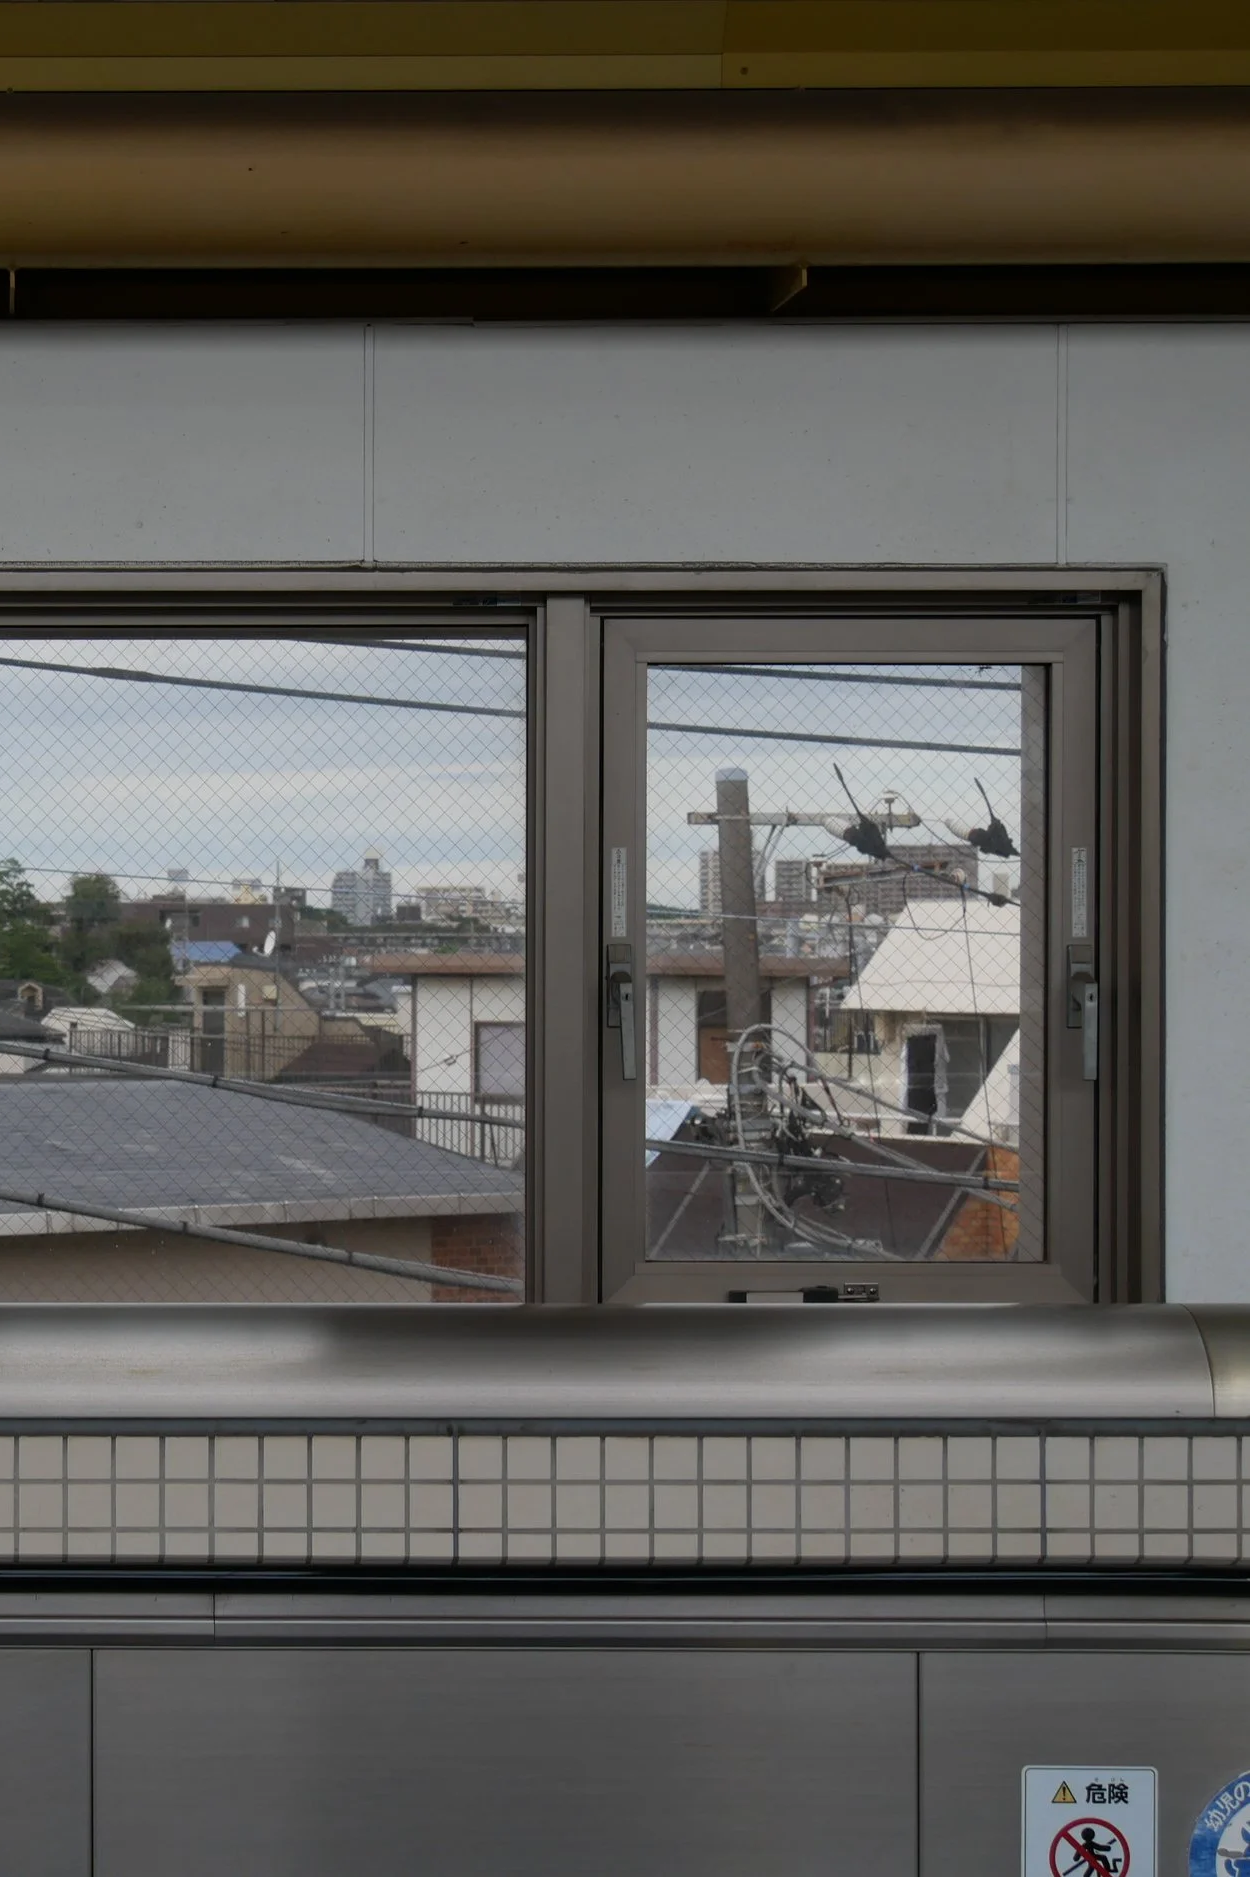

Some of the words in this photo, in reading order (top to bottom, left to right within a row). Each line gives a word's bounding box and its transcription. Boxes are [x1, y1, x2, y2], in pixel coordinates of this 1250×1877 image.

[1086, 1783, 1129, 1804] 危険
[1204, 1781, 1250, 1832] 幼児の
